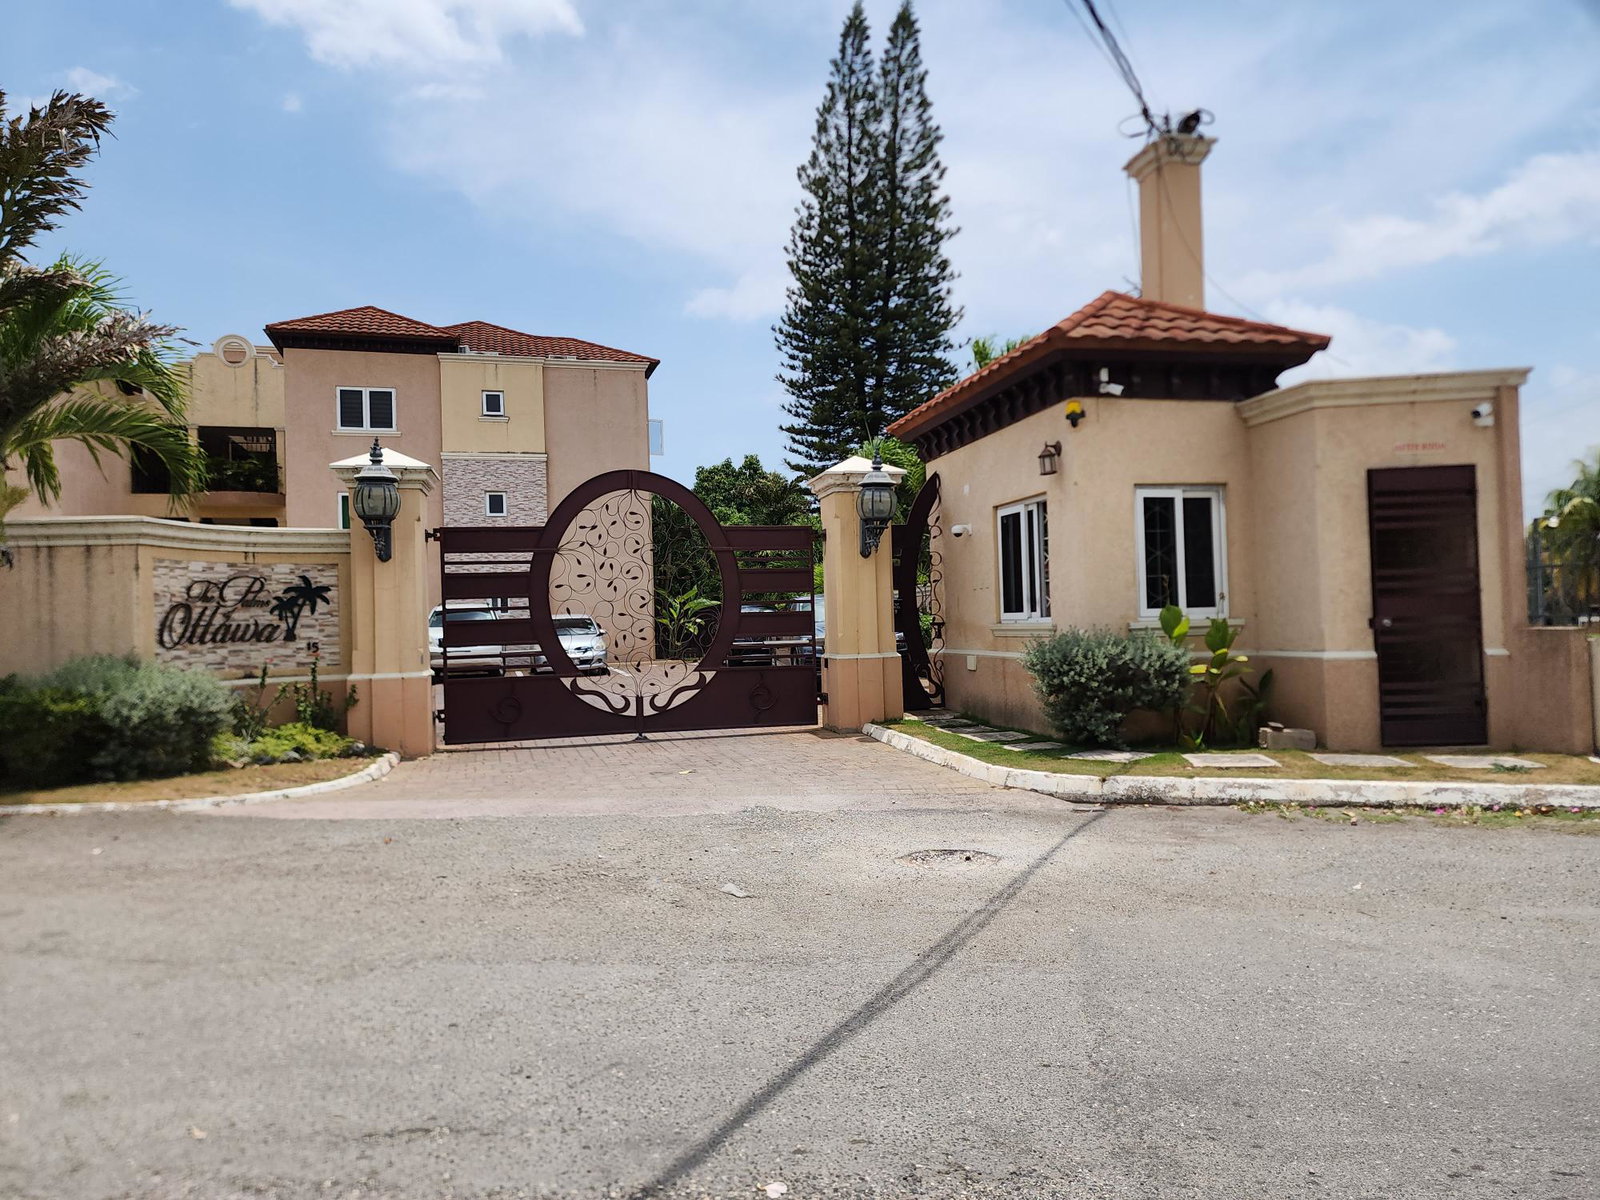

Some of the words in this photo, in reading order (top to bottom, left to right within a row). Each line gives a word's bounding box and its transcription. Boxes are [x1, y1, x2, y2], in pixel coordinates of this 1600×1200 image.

[186, 580, 219, 603] The
[217, 576, 271, 608] Palms
[158, 603, 283, 649] Ottawa
[306, 642, 320, 653] 15
